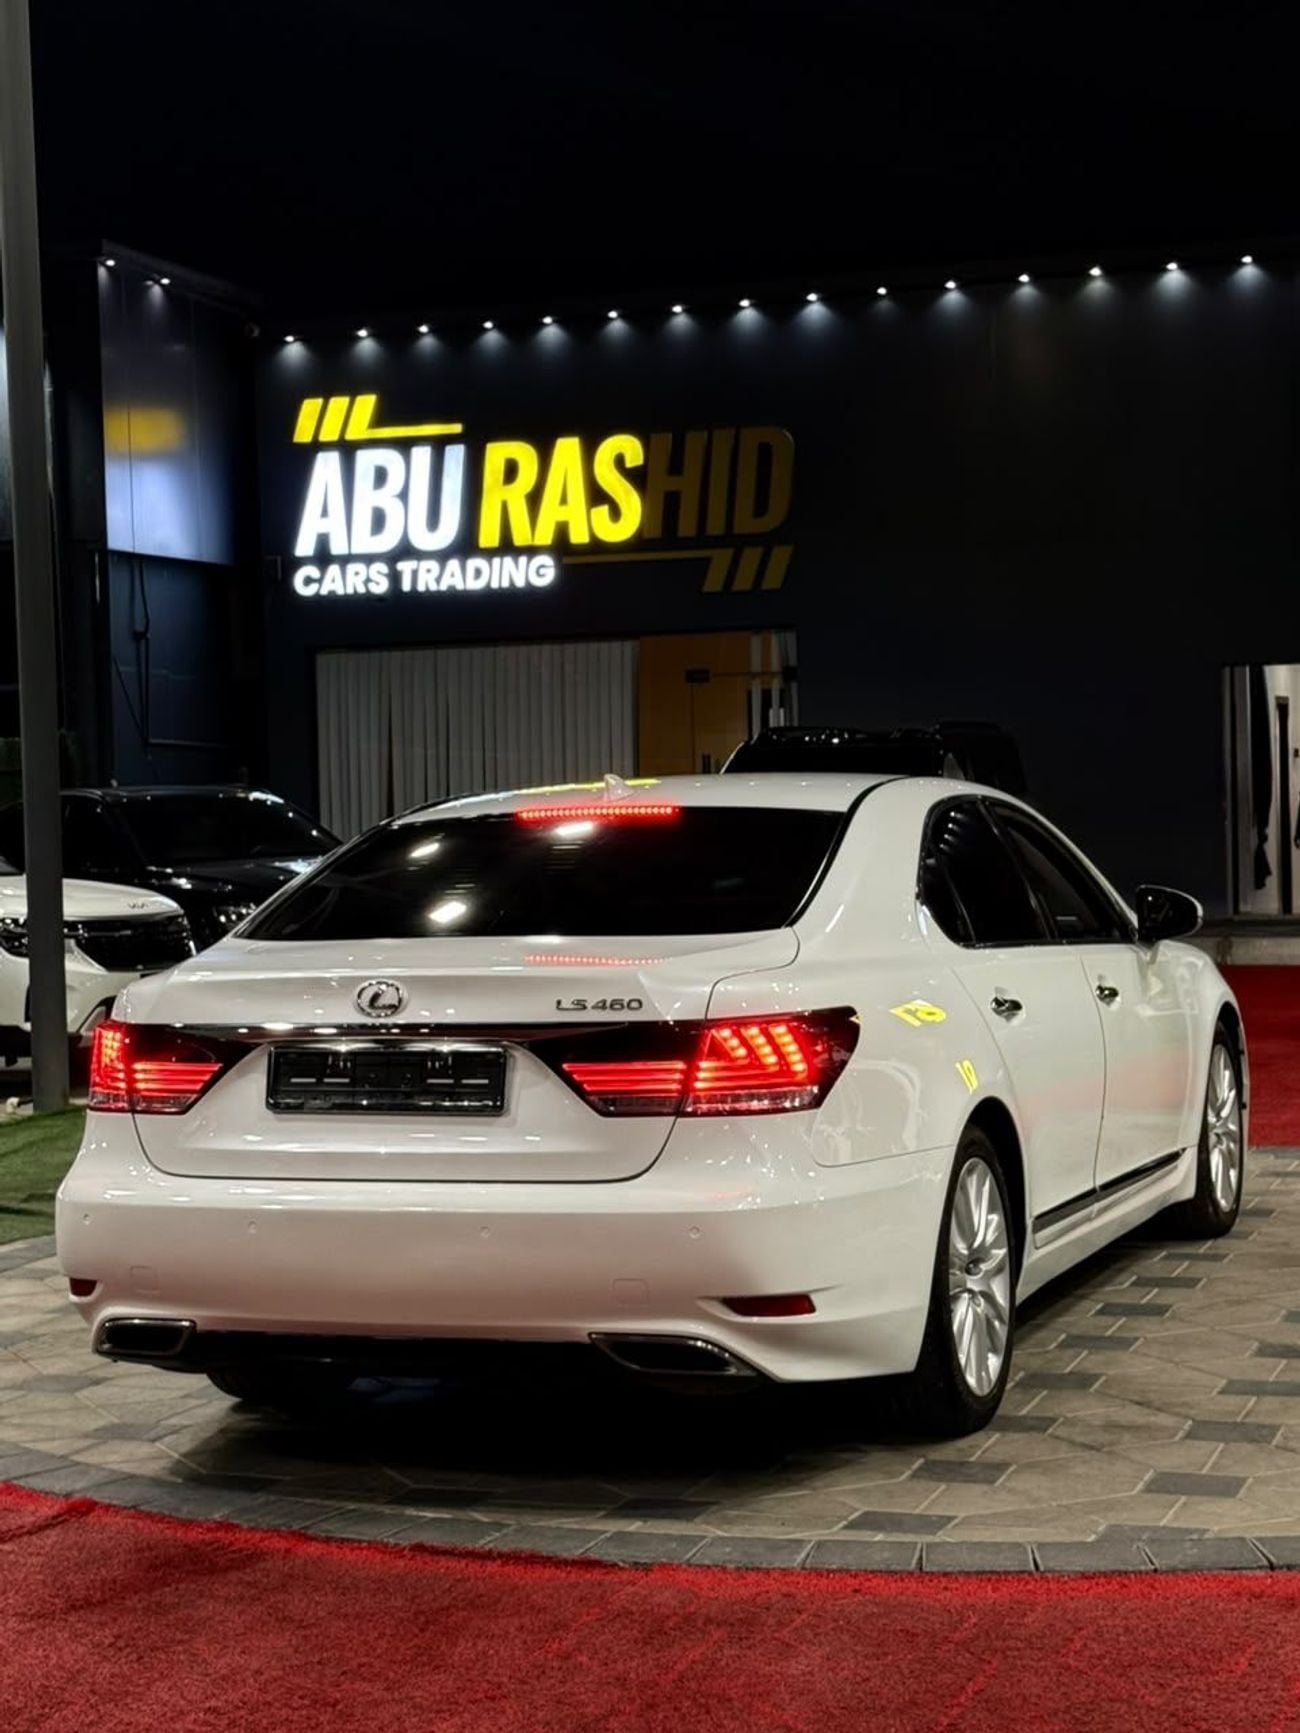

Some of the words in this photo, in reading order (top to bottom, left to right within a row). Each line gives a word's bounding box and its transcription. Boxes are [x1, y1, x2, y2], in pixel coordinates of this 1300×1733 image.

[294, 444, 465, 557] ABU
[479, 426, 795, 548] RASHID
[293, 562, 389, 596] CARS
[397, 556, 556, 592] TRADING
